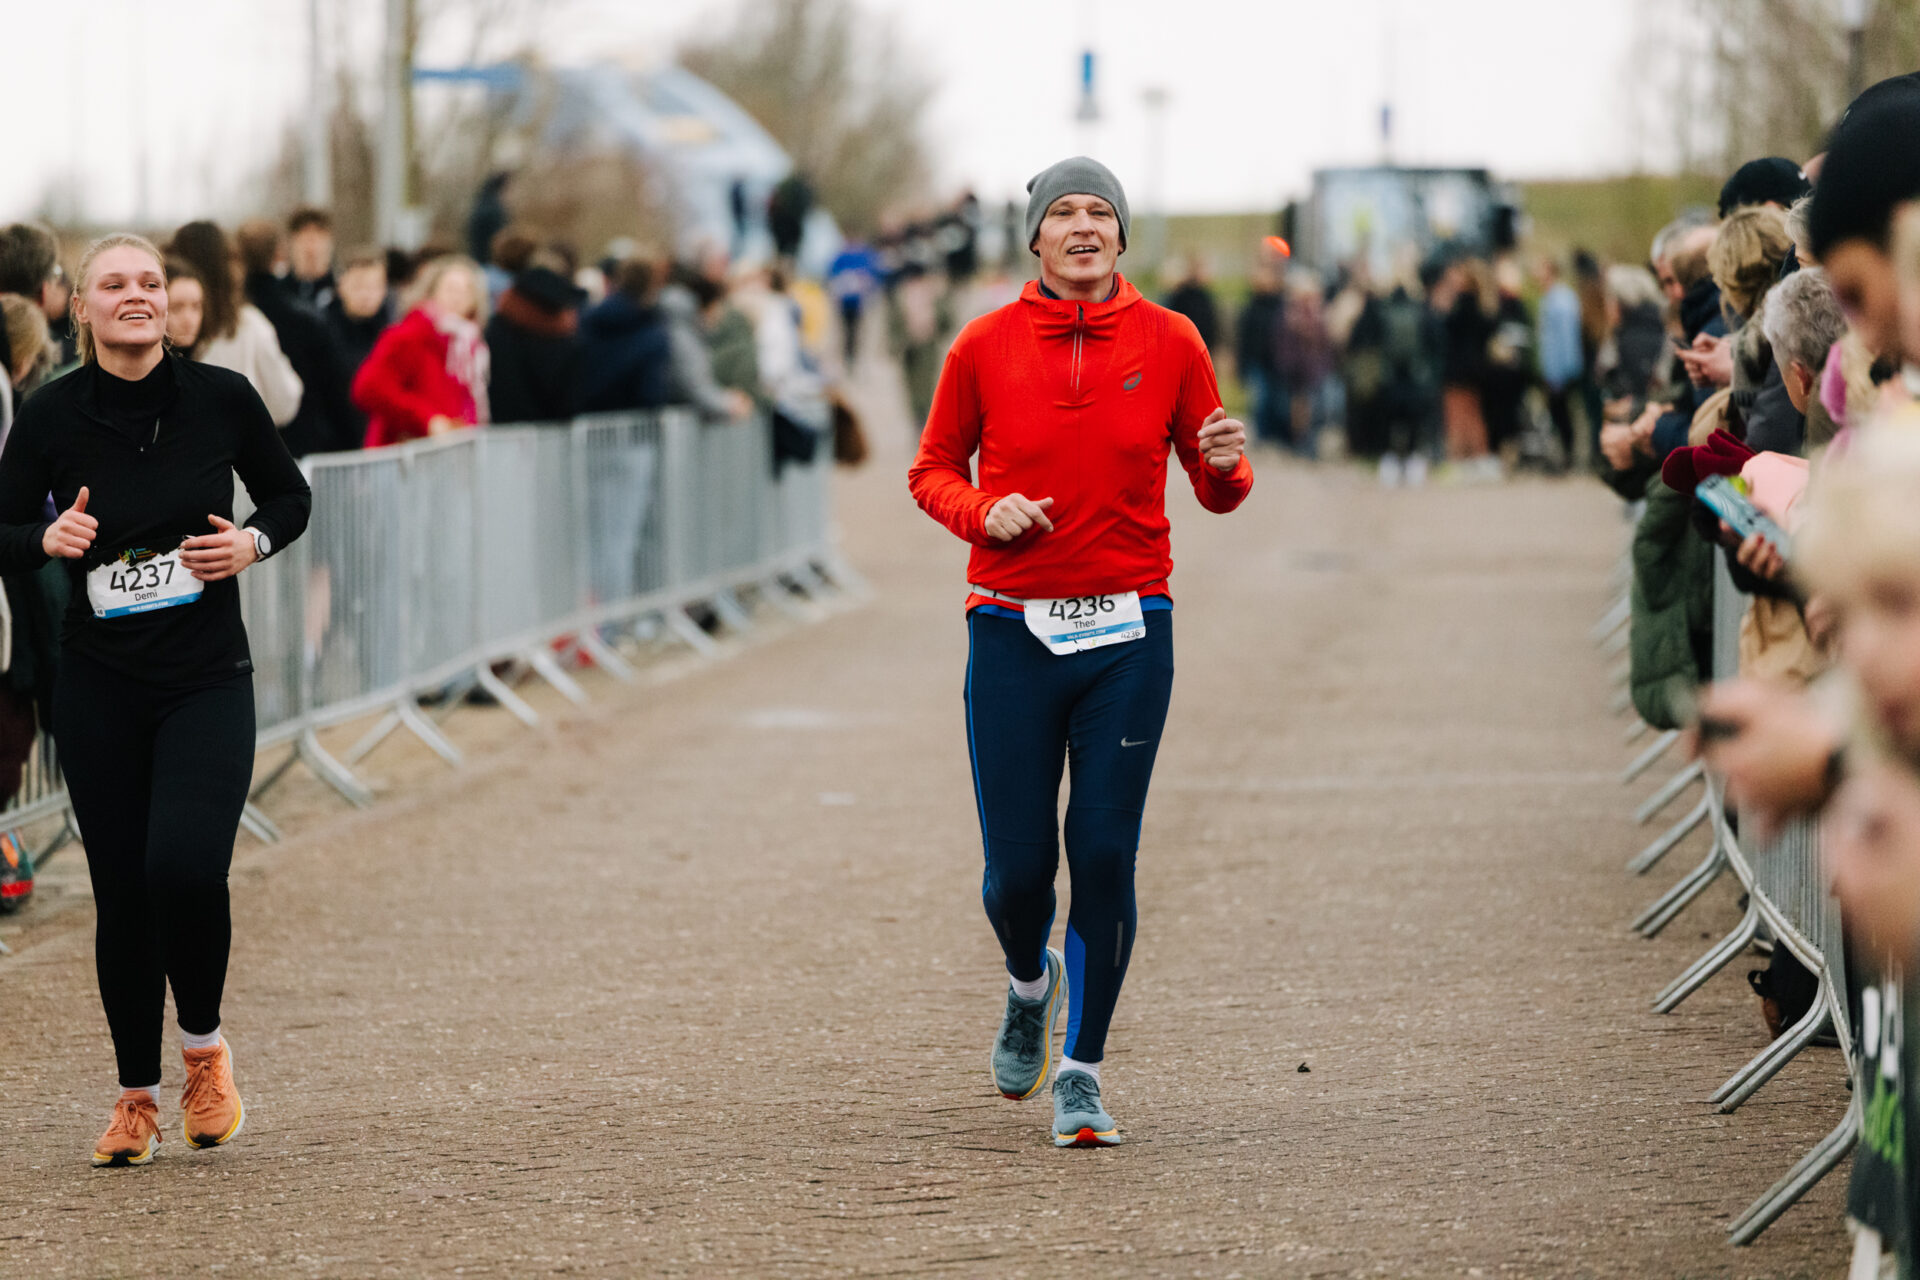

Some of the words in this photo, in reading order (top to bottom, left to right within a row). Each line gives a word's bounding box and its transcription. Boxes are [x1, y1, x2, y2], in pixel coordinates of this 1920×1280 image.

[110, 560, 175, 593] 4237
[134, 589, 158, 602] Demi
[1049, 594, 1115, 621] 4236
[1073, 619, 1096, 629] Theo
[1120, 630, 1141, 639] 4236
